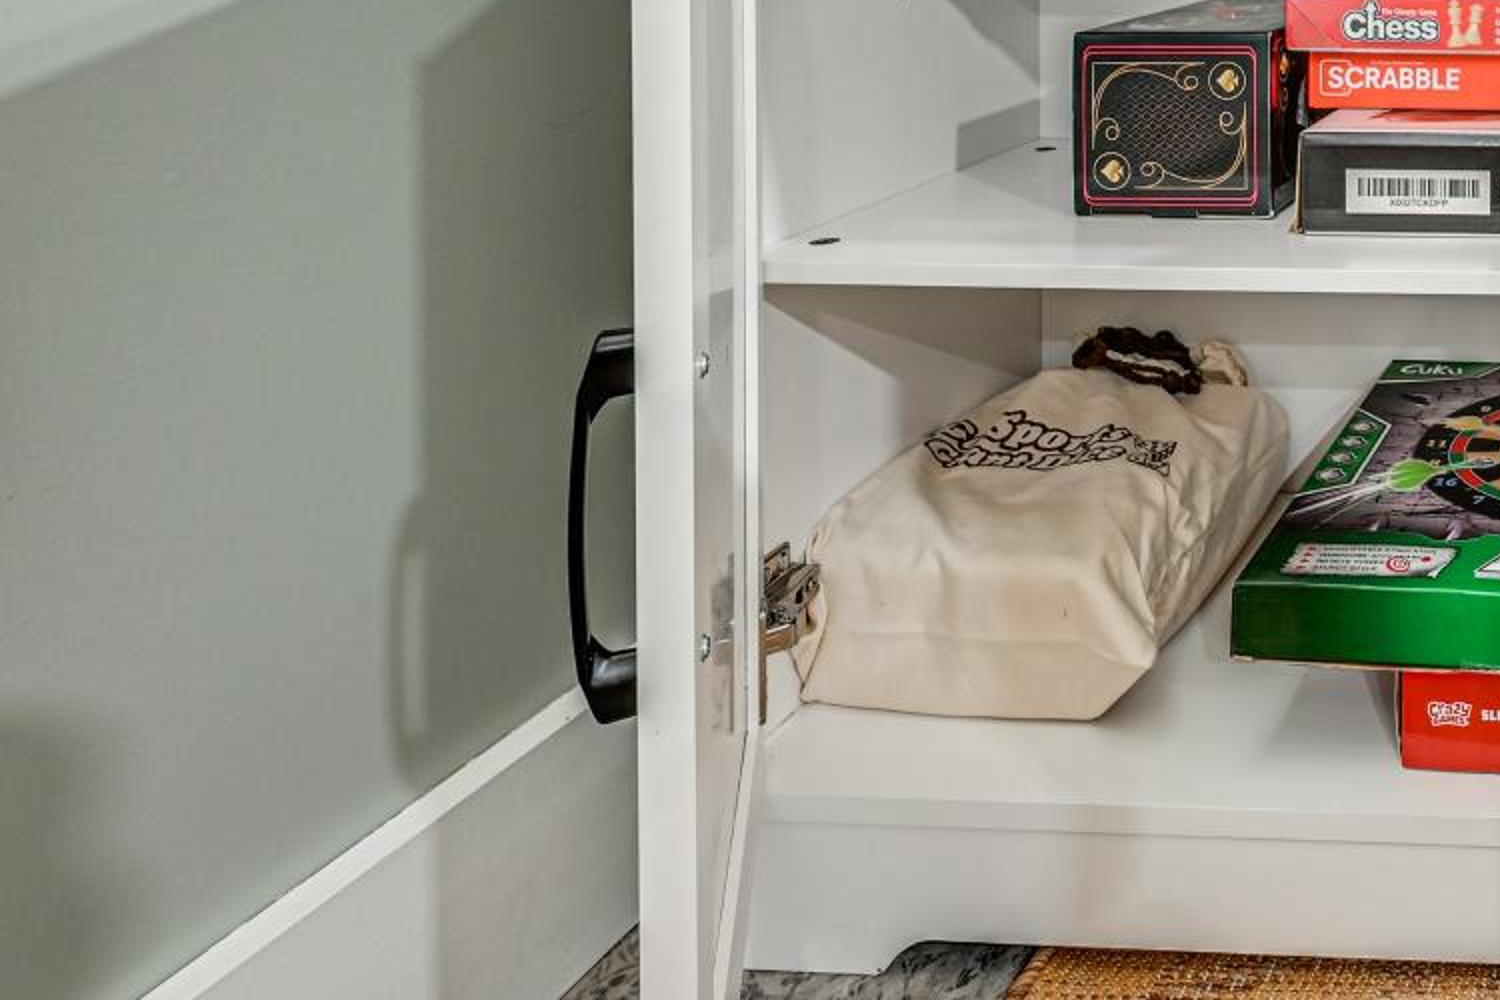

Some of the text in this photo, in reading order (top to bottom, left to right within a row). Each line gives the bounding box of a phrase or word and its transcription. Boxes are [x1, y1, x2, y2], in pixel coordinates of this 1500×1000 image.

[1343, 0, 1438, 40] Chess
[1327, 65, 1461, 91] SCRABBLE
[1433, 477, 1457, 487] 16
[1429, 703, 1472, 717] Crazy
